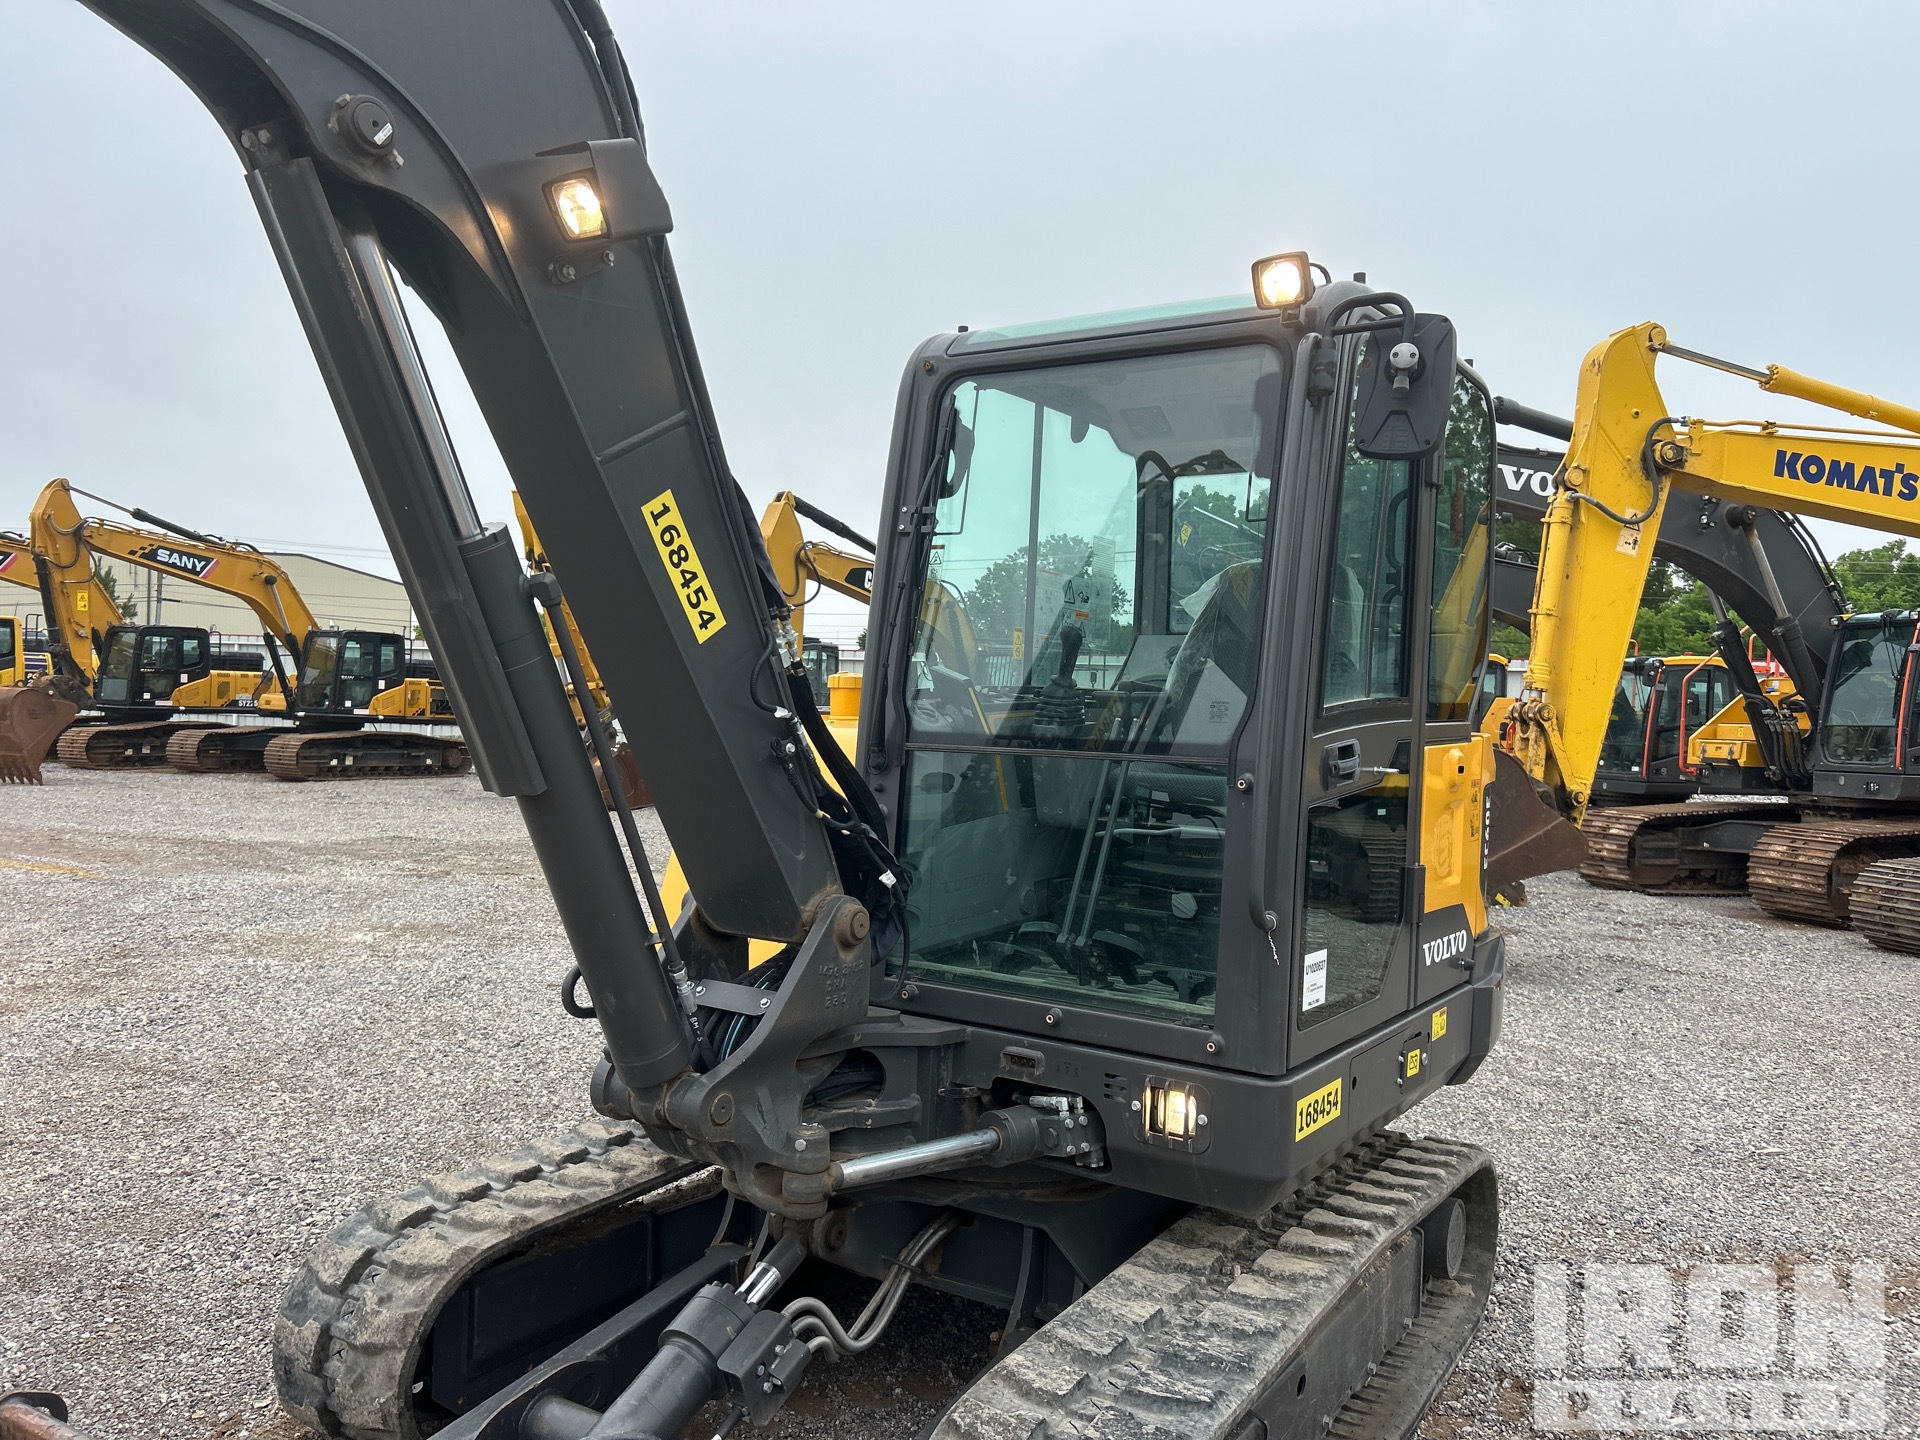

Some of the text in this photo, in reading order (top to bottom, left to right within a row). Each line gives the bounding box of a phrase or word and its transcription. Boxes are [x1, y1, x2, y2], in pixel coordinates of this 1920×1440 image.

[156, 548, 207, 572] SANY
[649, 502, 717, 631] 168454
[1422, 929, 1467, 967] VOLVO
[1297, 1087, 1340, 1134] 168454
